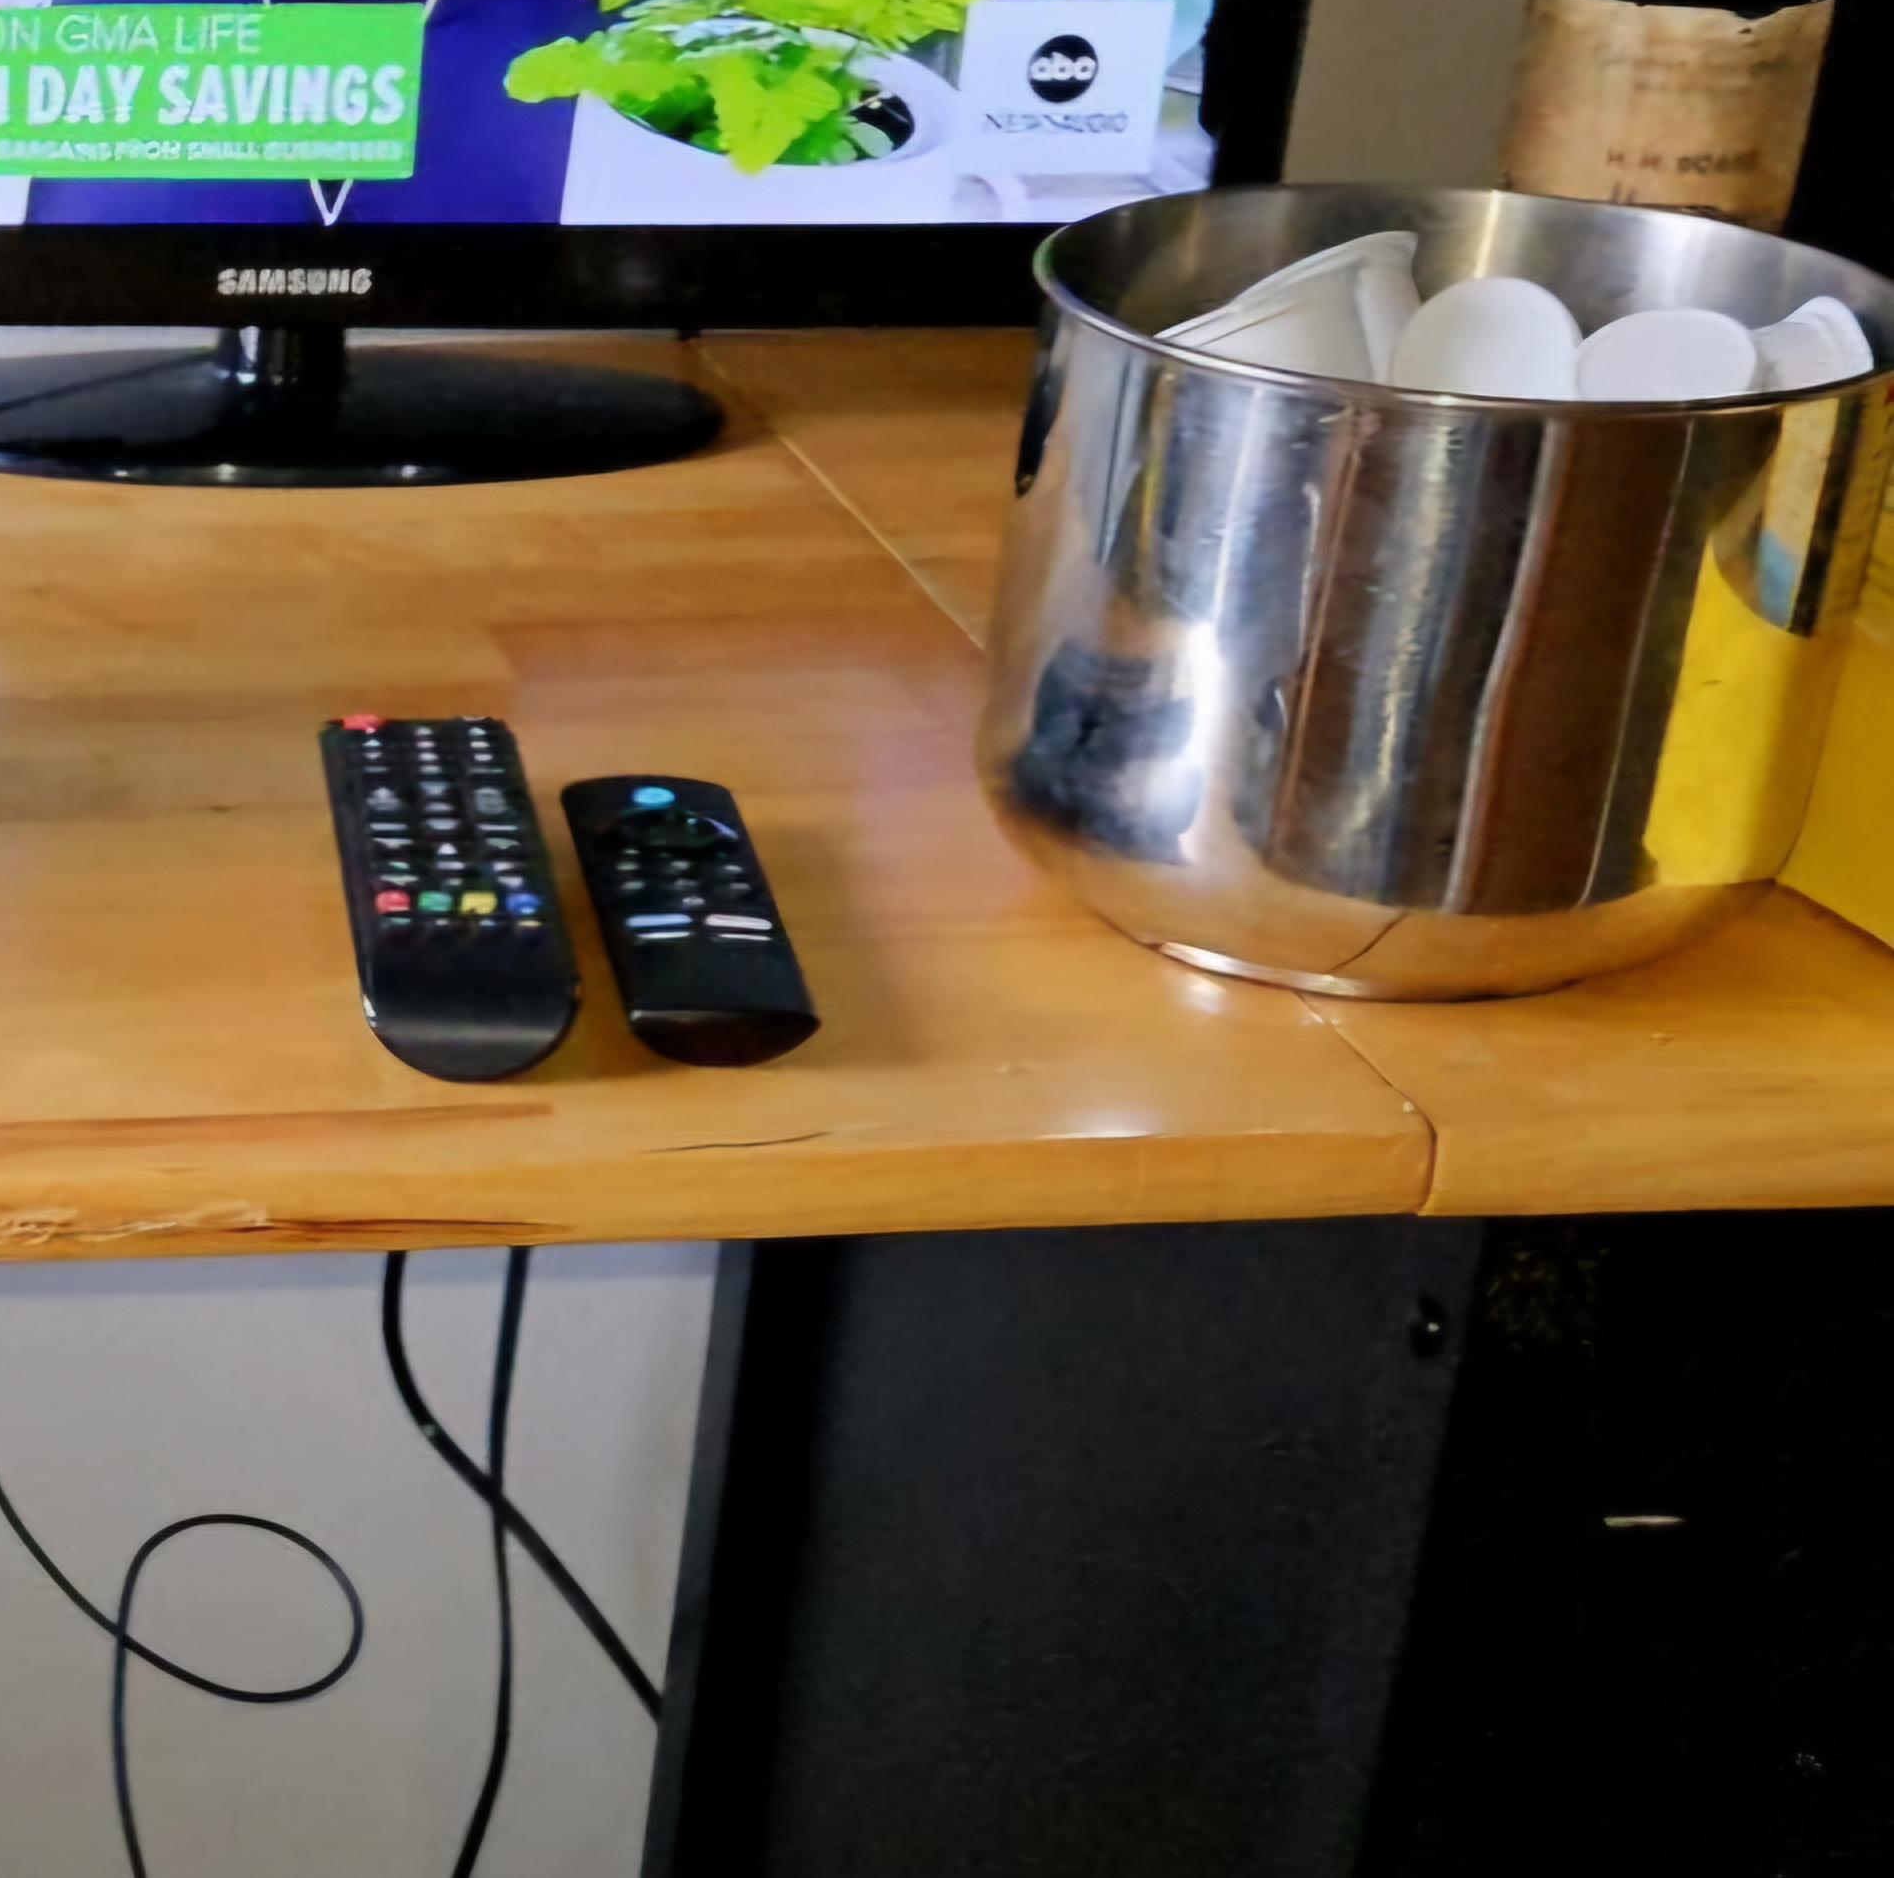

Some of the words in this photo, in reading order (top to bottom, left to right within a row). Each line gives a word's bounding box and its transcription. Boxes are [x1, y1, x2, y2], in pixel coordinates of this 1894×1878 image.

[55, 15, 159, 52] GMA
[174, 14, 262, 52] LIFE
[27, 64, 144, 123] DAY
[158, 63, 405, 124] SAVINGS
[217, 268, 372, 295] SAMSUNG
